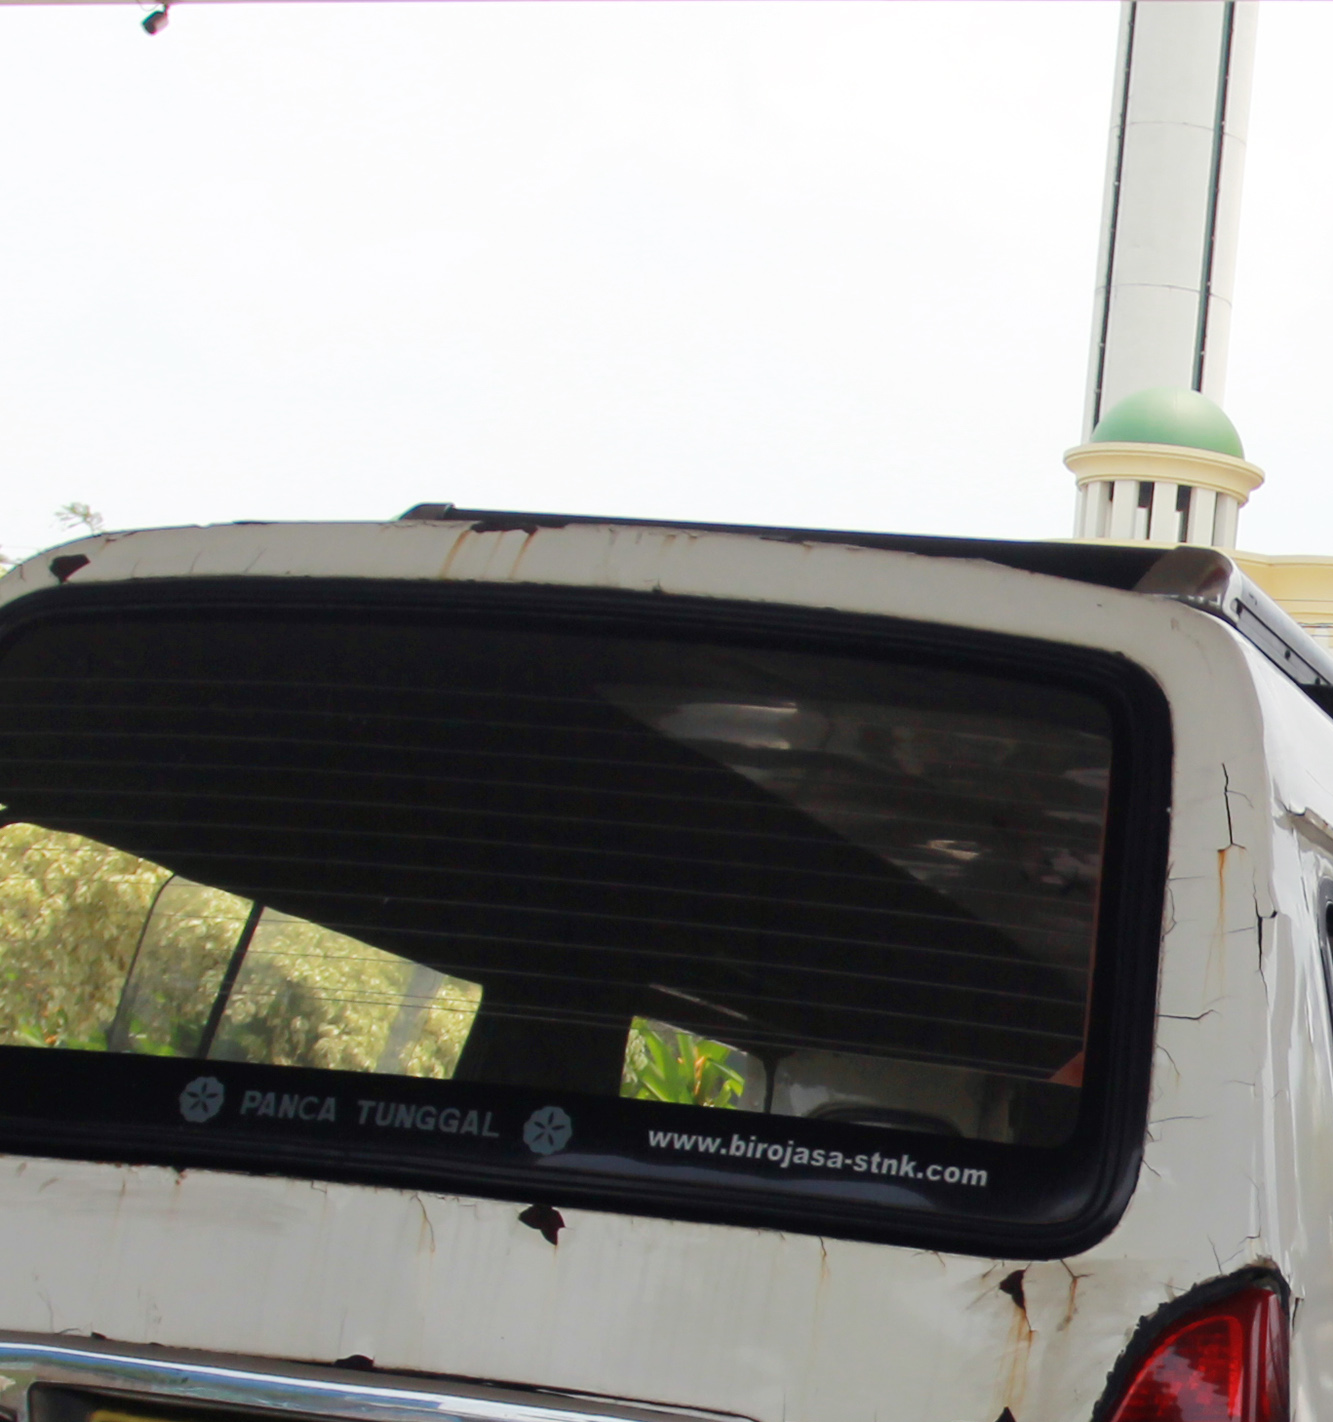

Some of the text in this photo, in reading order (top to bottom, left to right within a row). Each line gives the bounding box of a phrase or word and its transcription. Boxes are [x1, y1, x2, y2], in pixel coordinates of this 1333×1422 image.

[239, 1090, 500, 1139] PANCA TUNGGAL
[648, 1126, 989, 1187] www.birojasa-stnk.com
